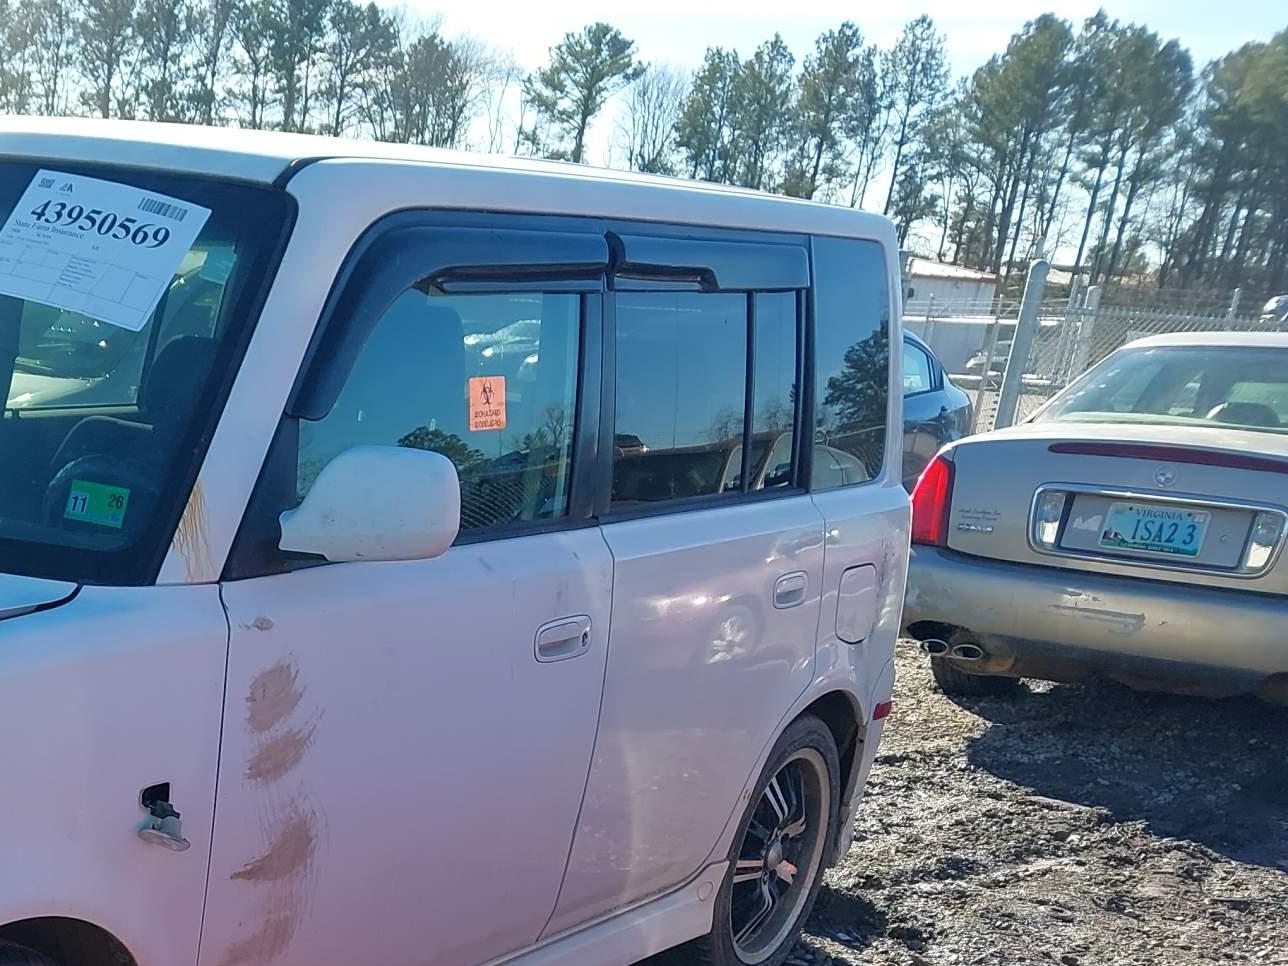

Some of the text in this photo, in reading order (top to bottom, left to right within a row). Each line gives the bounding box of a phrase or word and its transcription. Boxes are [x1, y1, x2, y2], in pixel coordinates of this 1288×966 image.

[30, 199, 171, 249] 43950569
[52, 225, 85, 239] Insurance
[71, 495, 88, 513] 11
[1135, 507, 1184, 521] VIRGINIA
